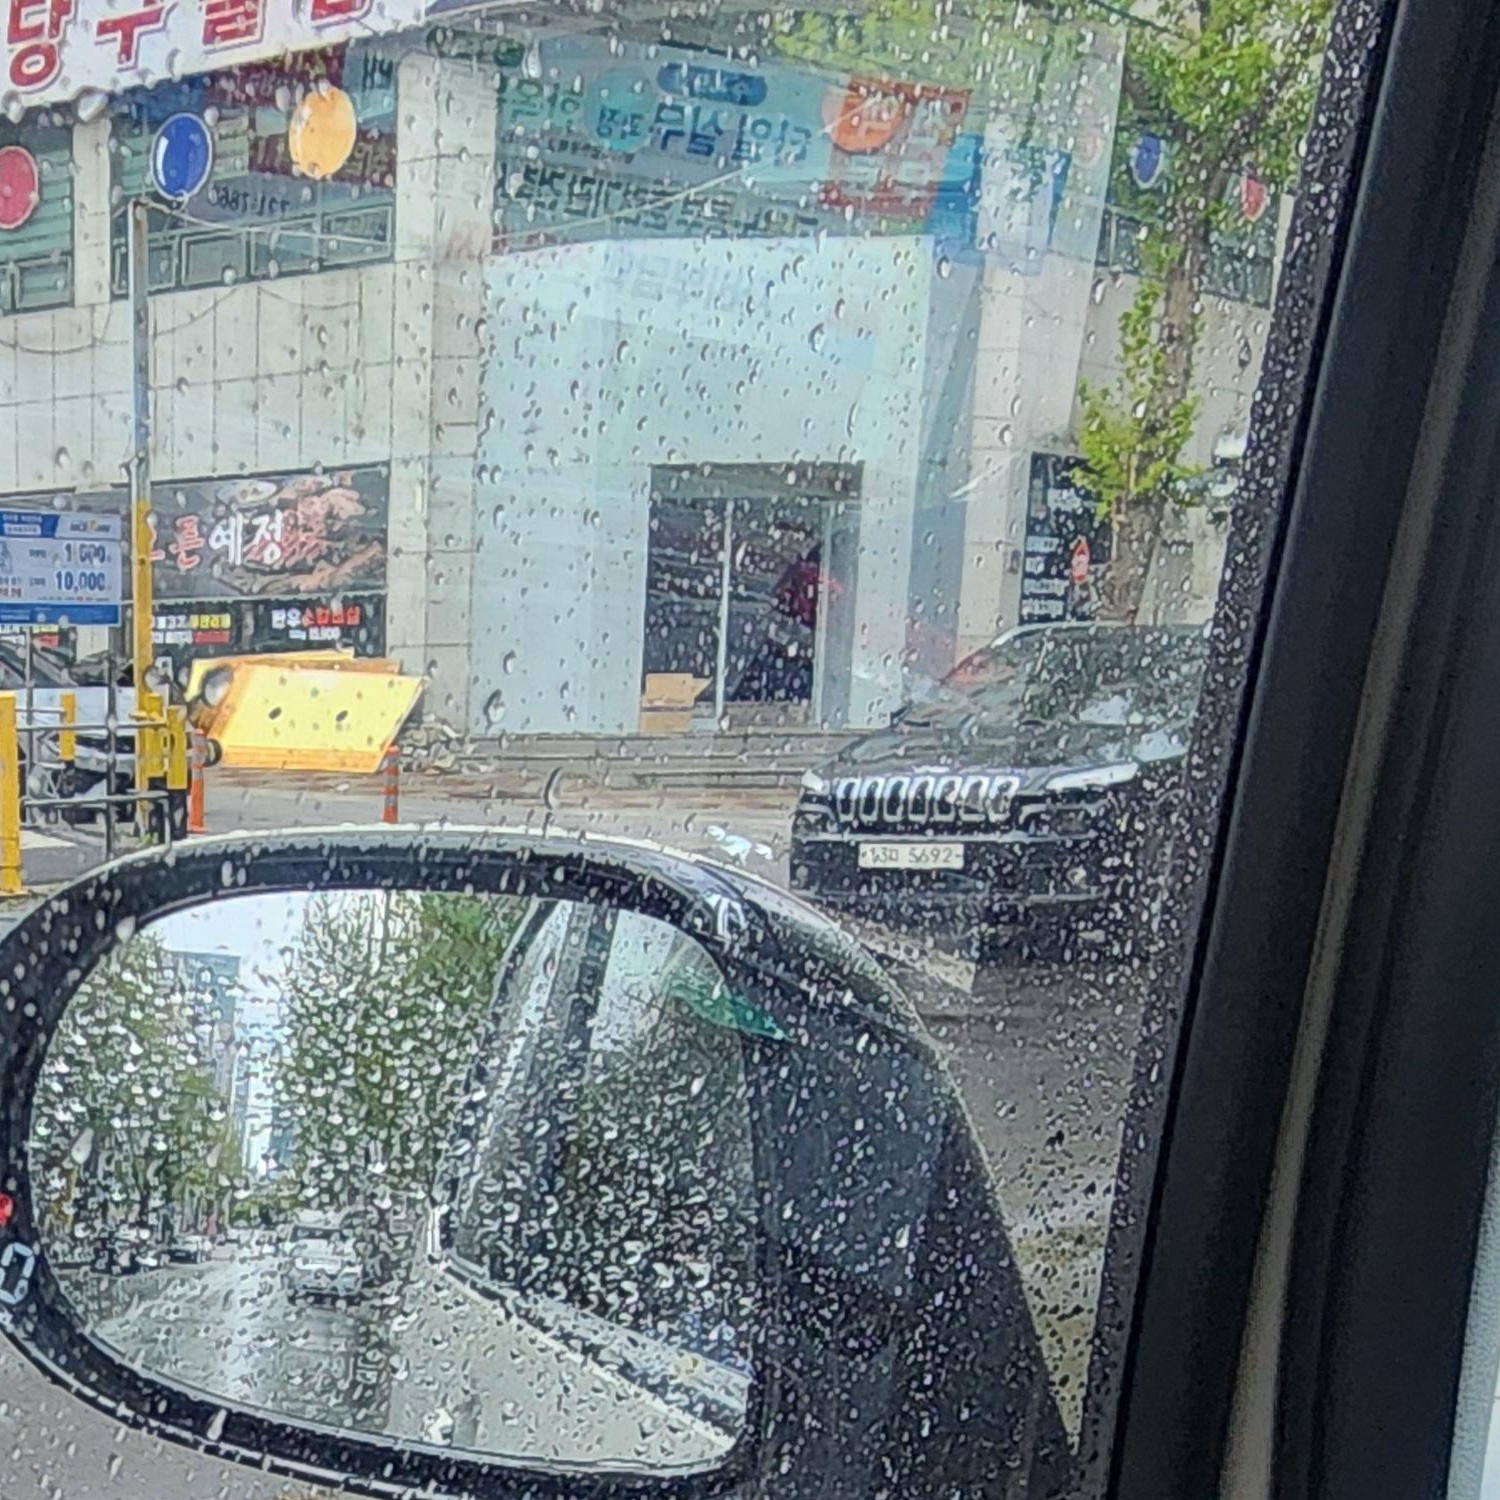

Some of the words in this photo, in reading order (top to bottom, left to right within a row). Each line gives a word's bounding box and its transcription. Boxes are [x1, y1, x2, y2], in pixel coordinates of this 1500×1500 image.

[65, 542, 106, 564] 1000
[56, 570, 106, 593] 10,000
[908, 847, 953, 864] 5692
